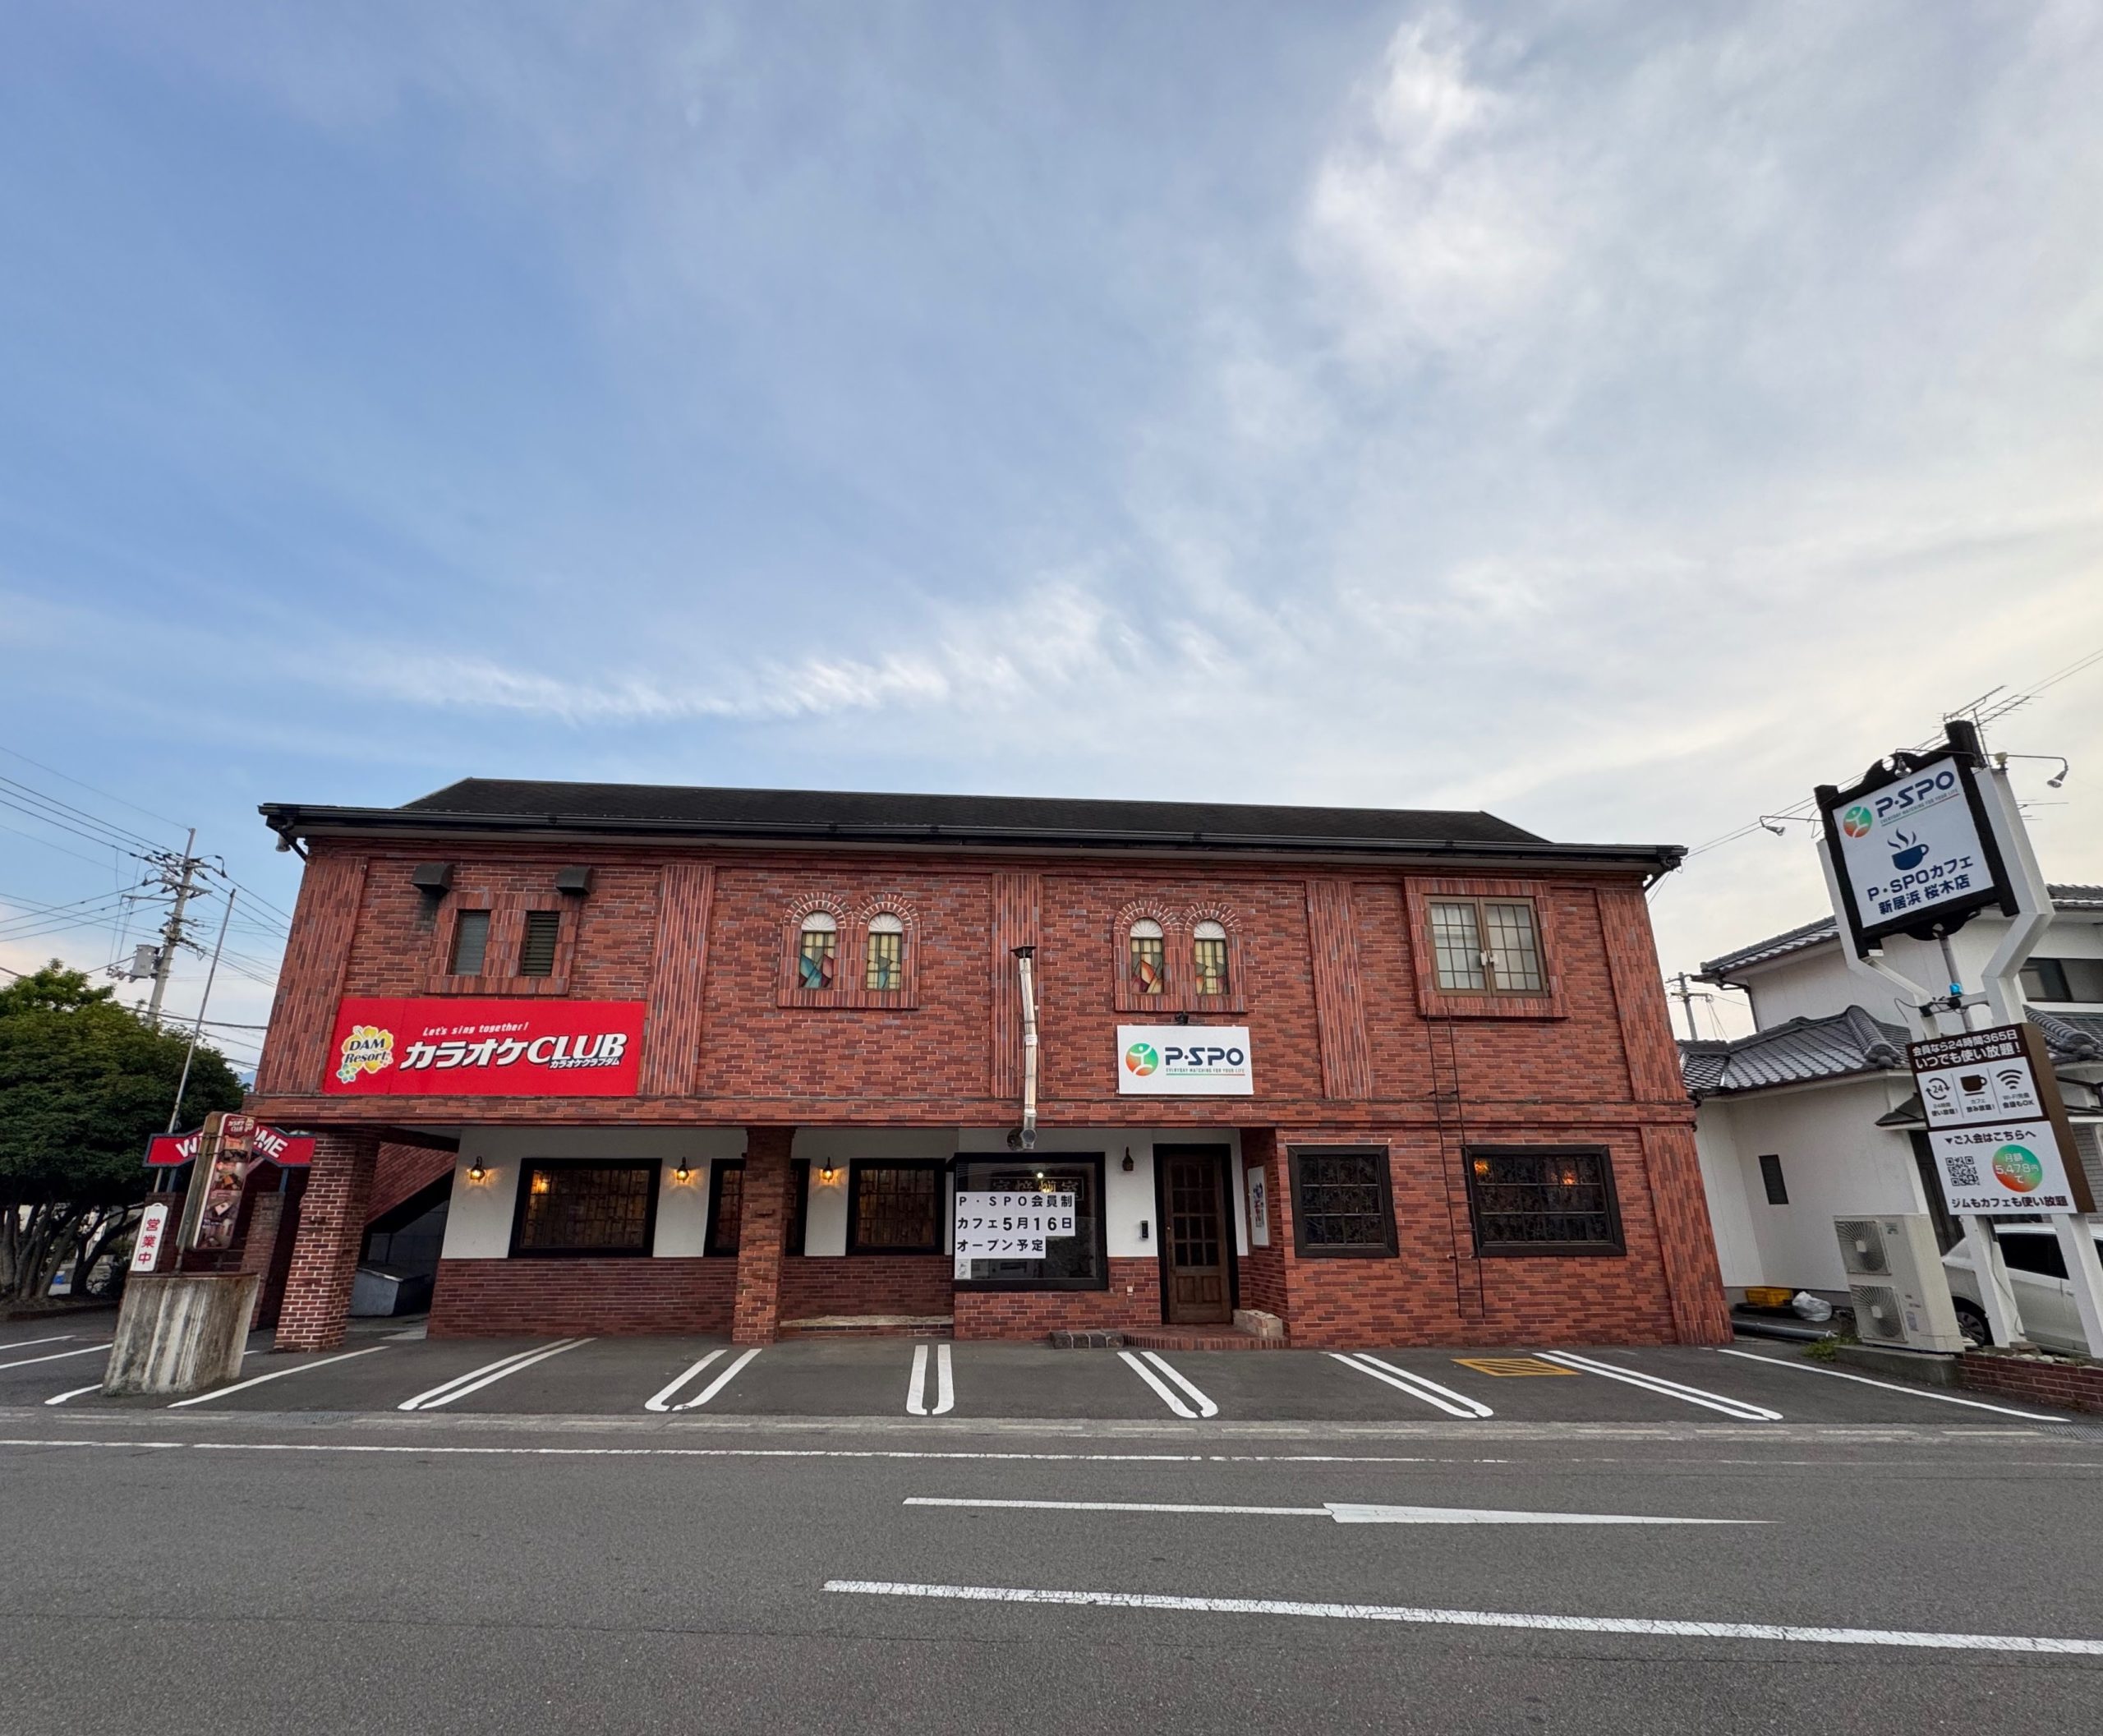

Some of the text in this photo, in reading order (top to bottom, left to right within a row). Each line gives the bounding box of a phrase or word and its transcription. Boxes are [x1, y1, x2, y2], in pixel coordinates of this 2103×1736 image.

[422, 1021, 529, 1036] Let's sing together!
[349, 1038, 384, 1051] DAM
[1912, 1029, 2018, 1057] 会員なら24時間365日
[344, 1051, 387, 1064] Resort
[1932, 1084, 1944, 1094] 24
[1951, 1195, 2069, 1209] ジムもカフェも使い放題
[957, 1217, 1073, 1232] カフェ5月16日
[138, 1218, 160, 1264] 営業中
[957, 1239, 1044, 1252] オープン予定
